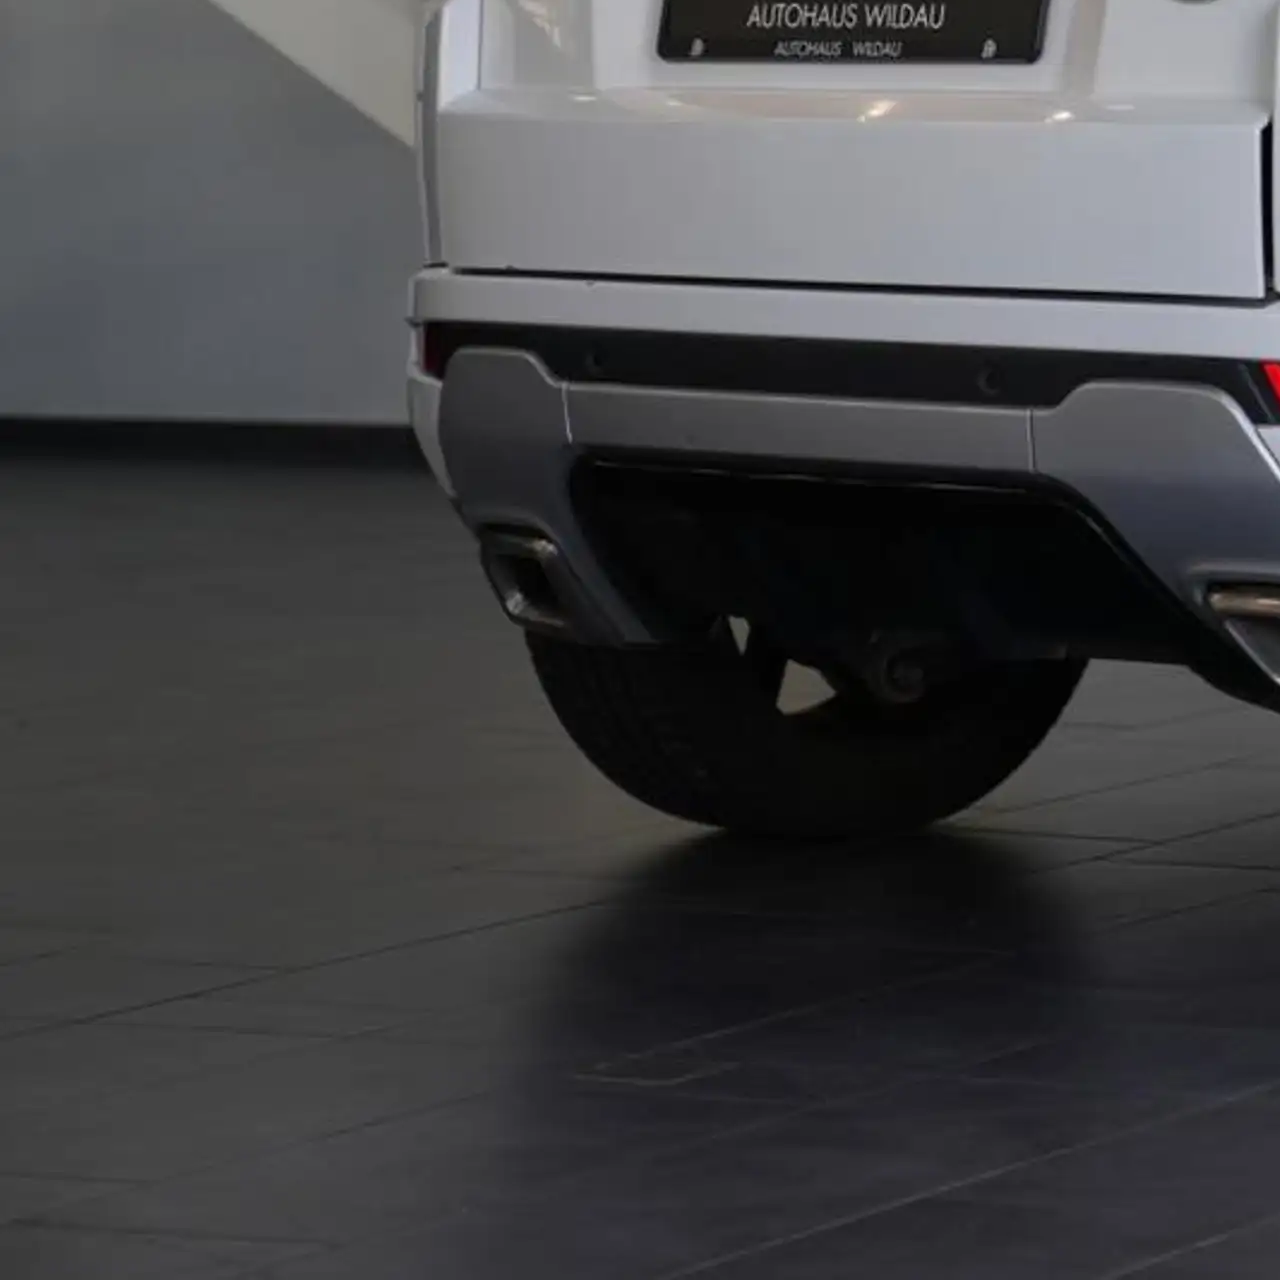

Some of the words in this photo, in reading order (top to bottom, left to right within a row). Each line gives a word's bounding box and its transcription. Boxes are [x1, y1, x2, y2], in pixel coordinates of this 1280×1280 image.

[746, 2, 858, 29] AUTOHAUS
[864, 3, 946, 30] WILDAU
[773, 40, 843, 57] AUTOHAUS
[852, 40, 903, 57] WILDAU
